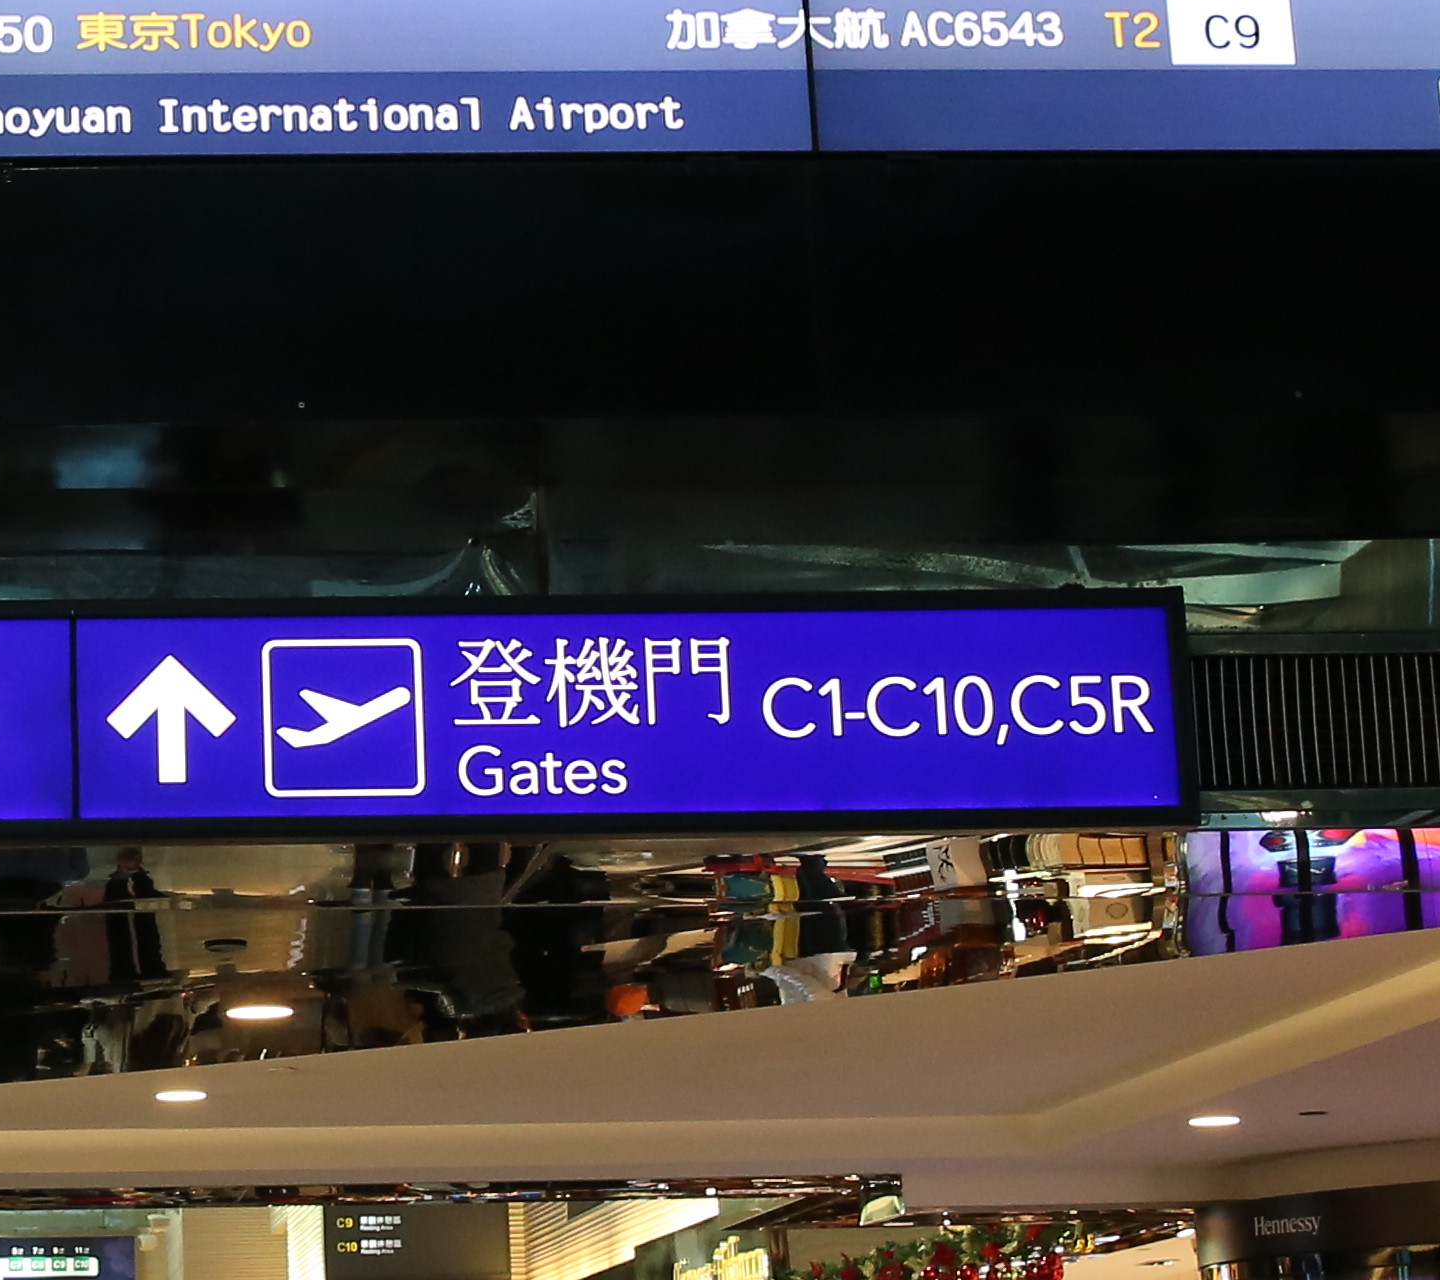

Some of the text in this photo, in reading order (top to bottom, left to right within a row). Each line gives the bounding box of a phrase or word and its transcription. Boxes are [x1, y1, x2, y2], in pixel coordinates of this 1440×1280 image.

[665, 7, 890, 50] 加拿大航
[900, 10, 1064, 47] AC6543
[1104, 11, 1161, 48] T2
[1204, 14, 1260, 50] C9
[158, 97, 480, 133] International
[509, 96, 684, 134] Airport
[450, 636, 1154, 746] 登機門 C1-C10,C5R
[458, 744, 628, 797] Gates
[336, 1217, 354, 1229] C9
[1254, 1215, 1321, 1237] Hennessy
[337, 1241, 358, 1253] C10
